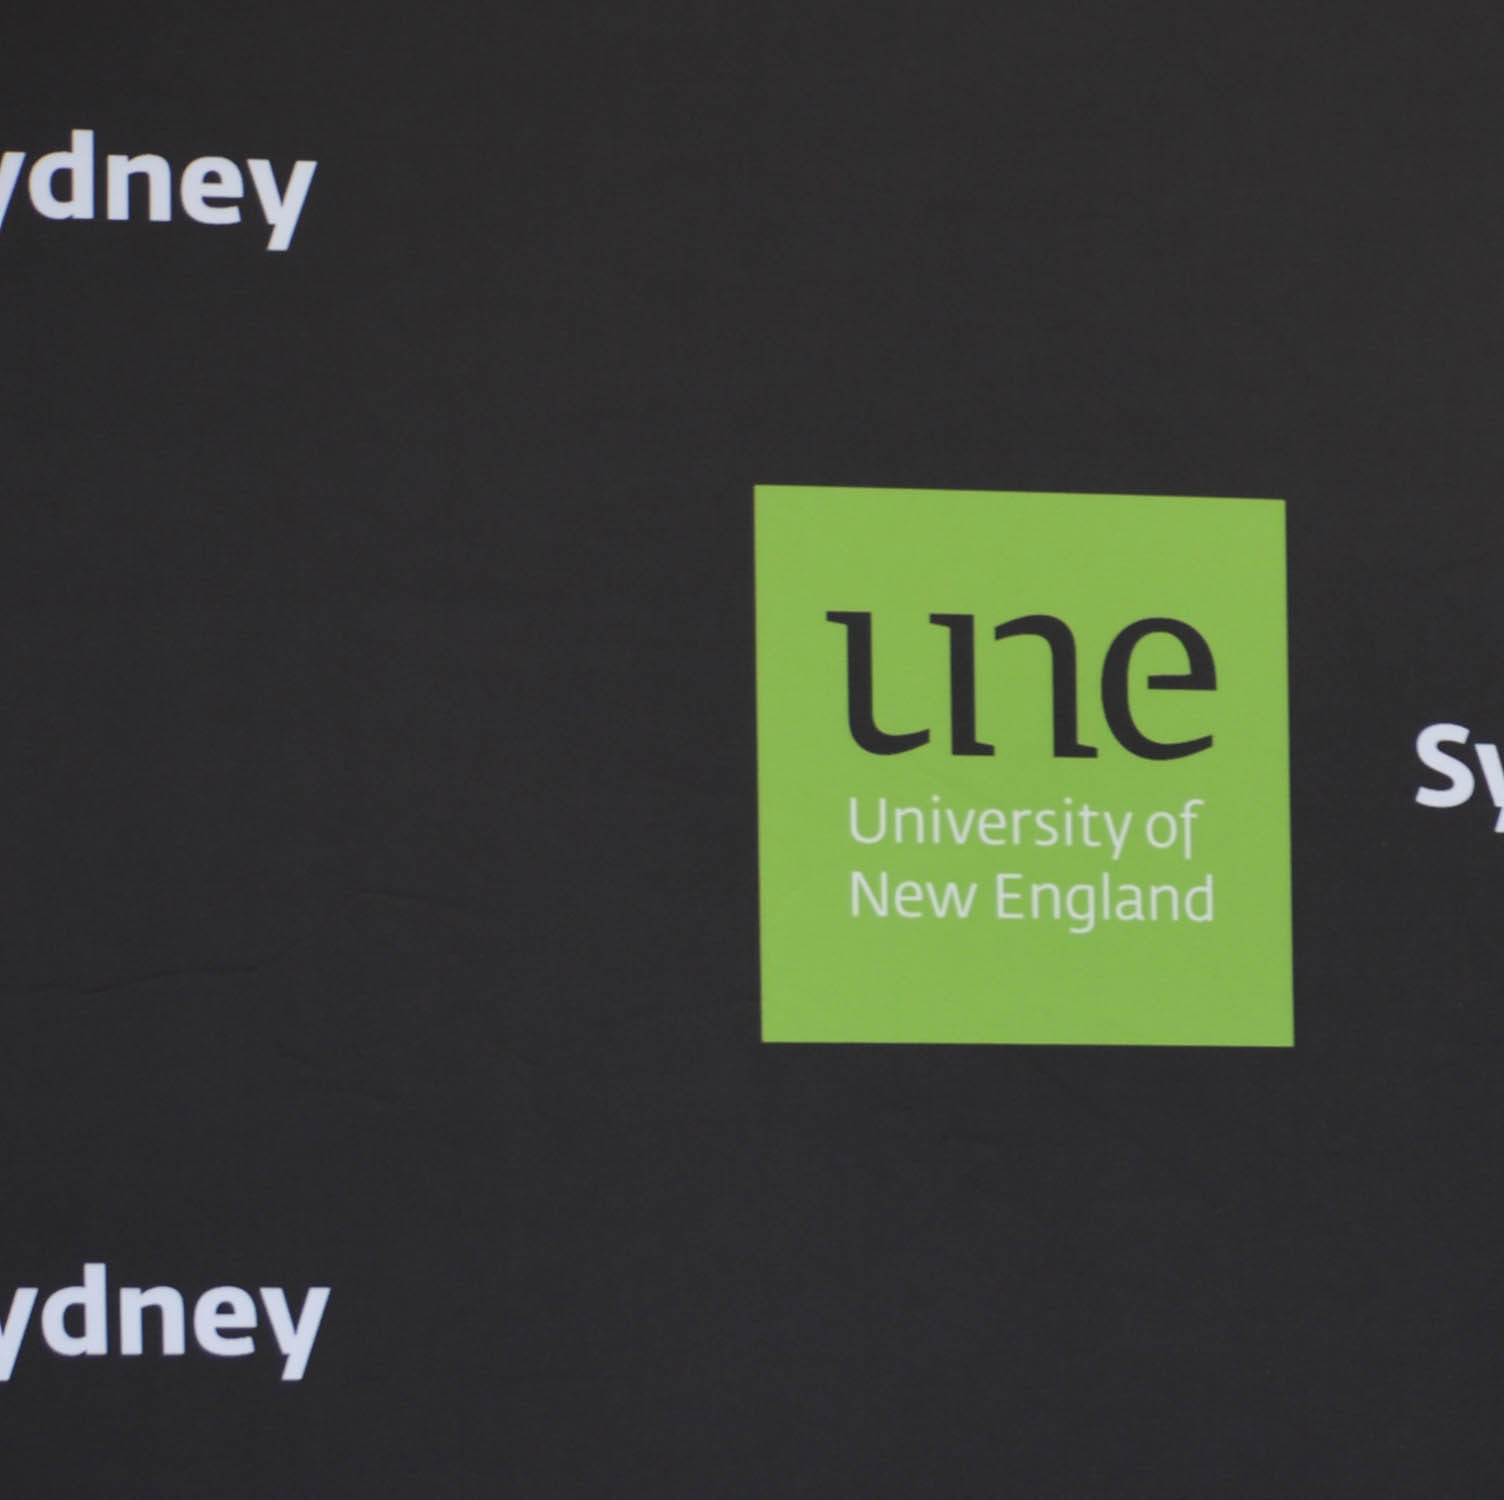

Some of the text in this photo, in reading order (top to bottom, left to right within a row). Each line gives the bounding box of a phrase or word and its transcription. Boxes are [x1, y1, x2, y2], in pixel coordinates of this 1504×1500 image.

[825, 610, 1218, 762] une
[848, 795, 1205, 861] University of
[850, 870, 1215, 935] New England
